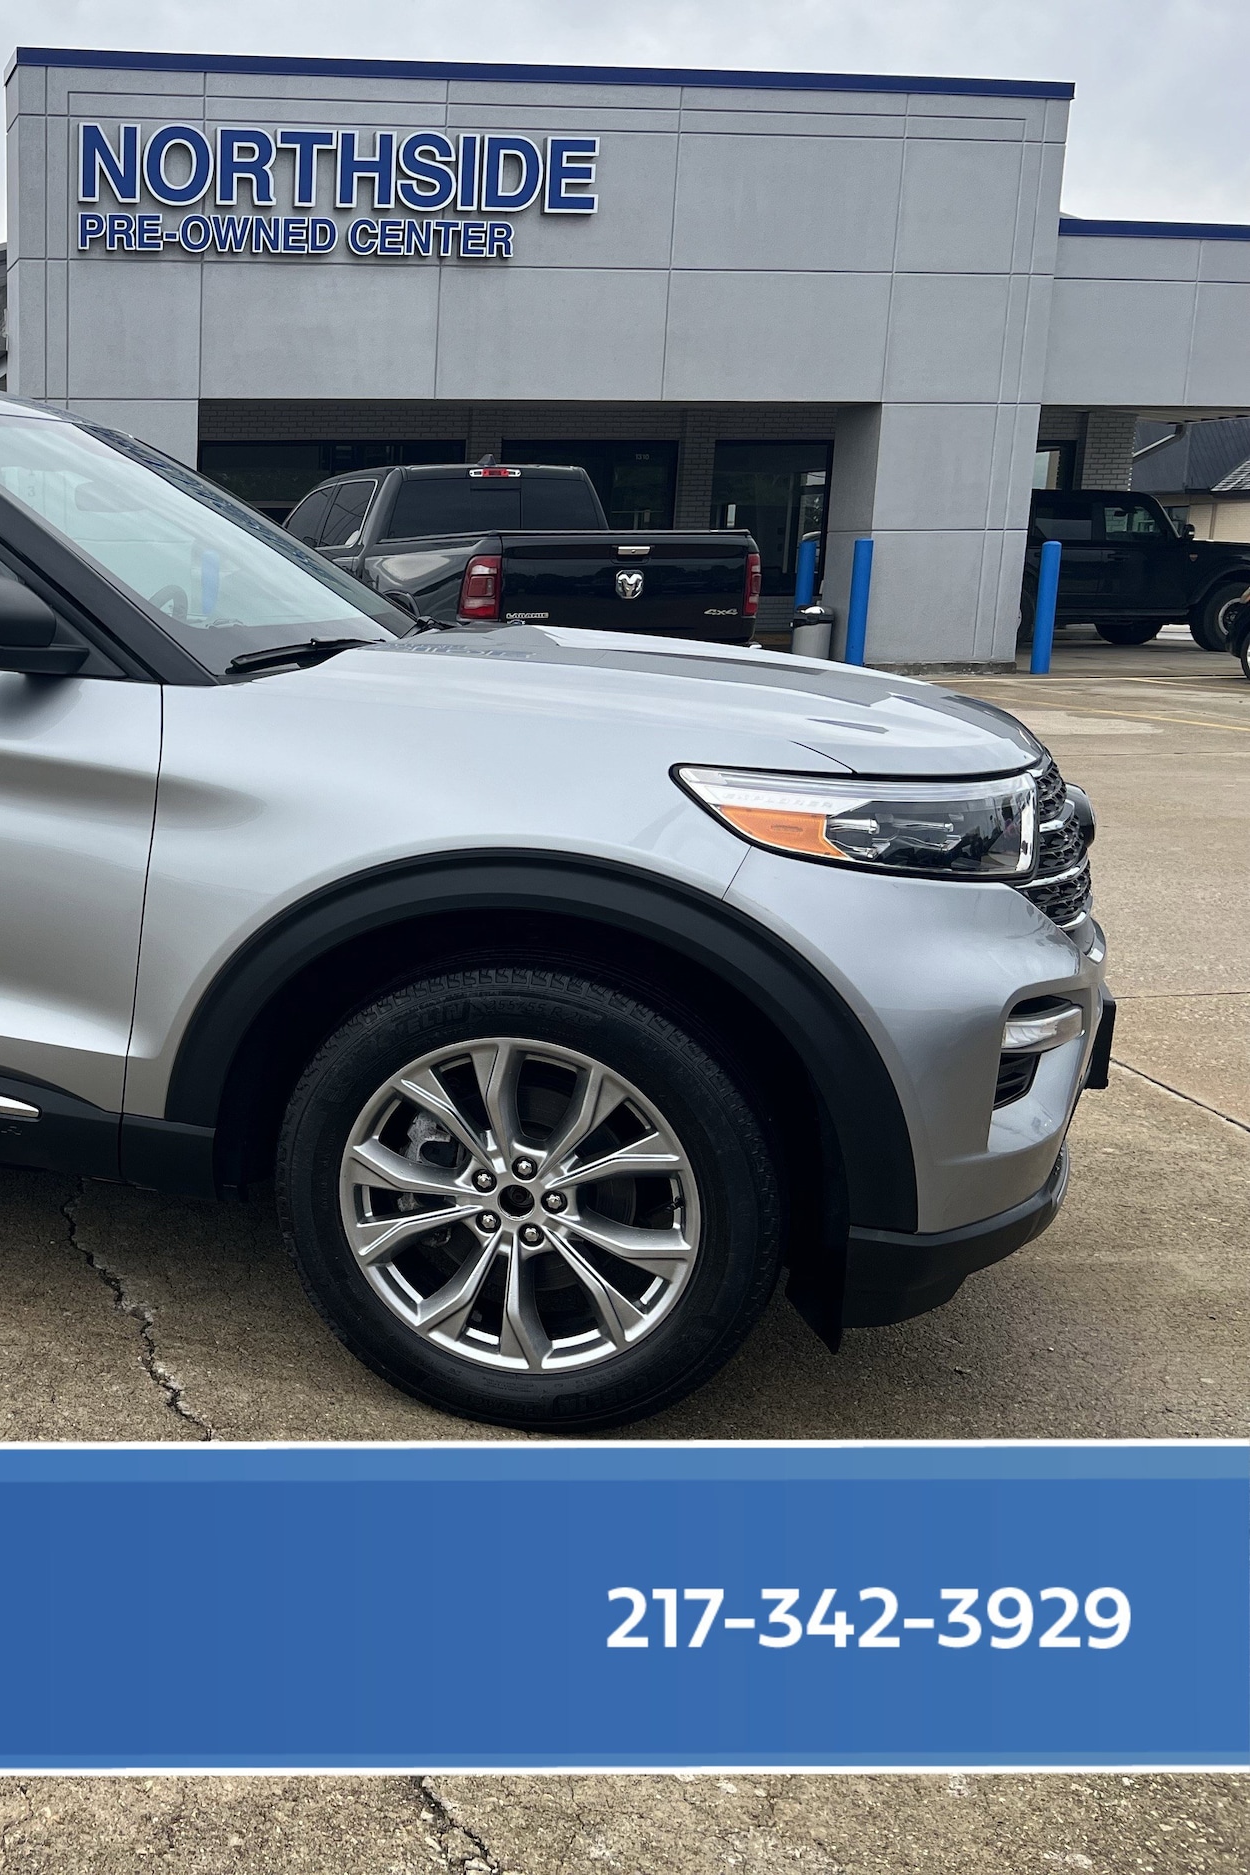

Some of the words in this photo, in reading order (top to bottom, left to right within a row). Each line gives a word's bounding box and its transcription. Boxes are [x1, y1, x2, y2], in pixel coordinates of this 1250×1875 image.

[77, 122, 600, 214] NORTHSIDE
[77, 212, 338, 255] PRE-OWNED
[347, 217, 514, 259] CENTER
